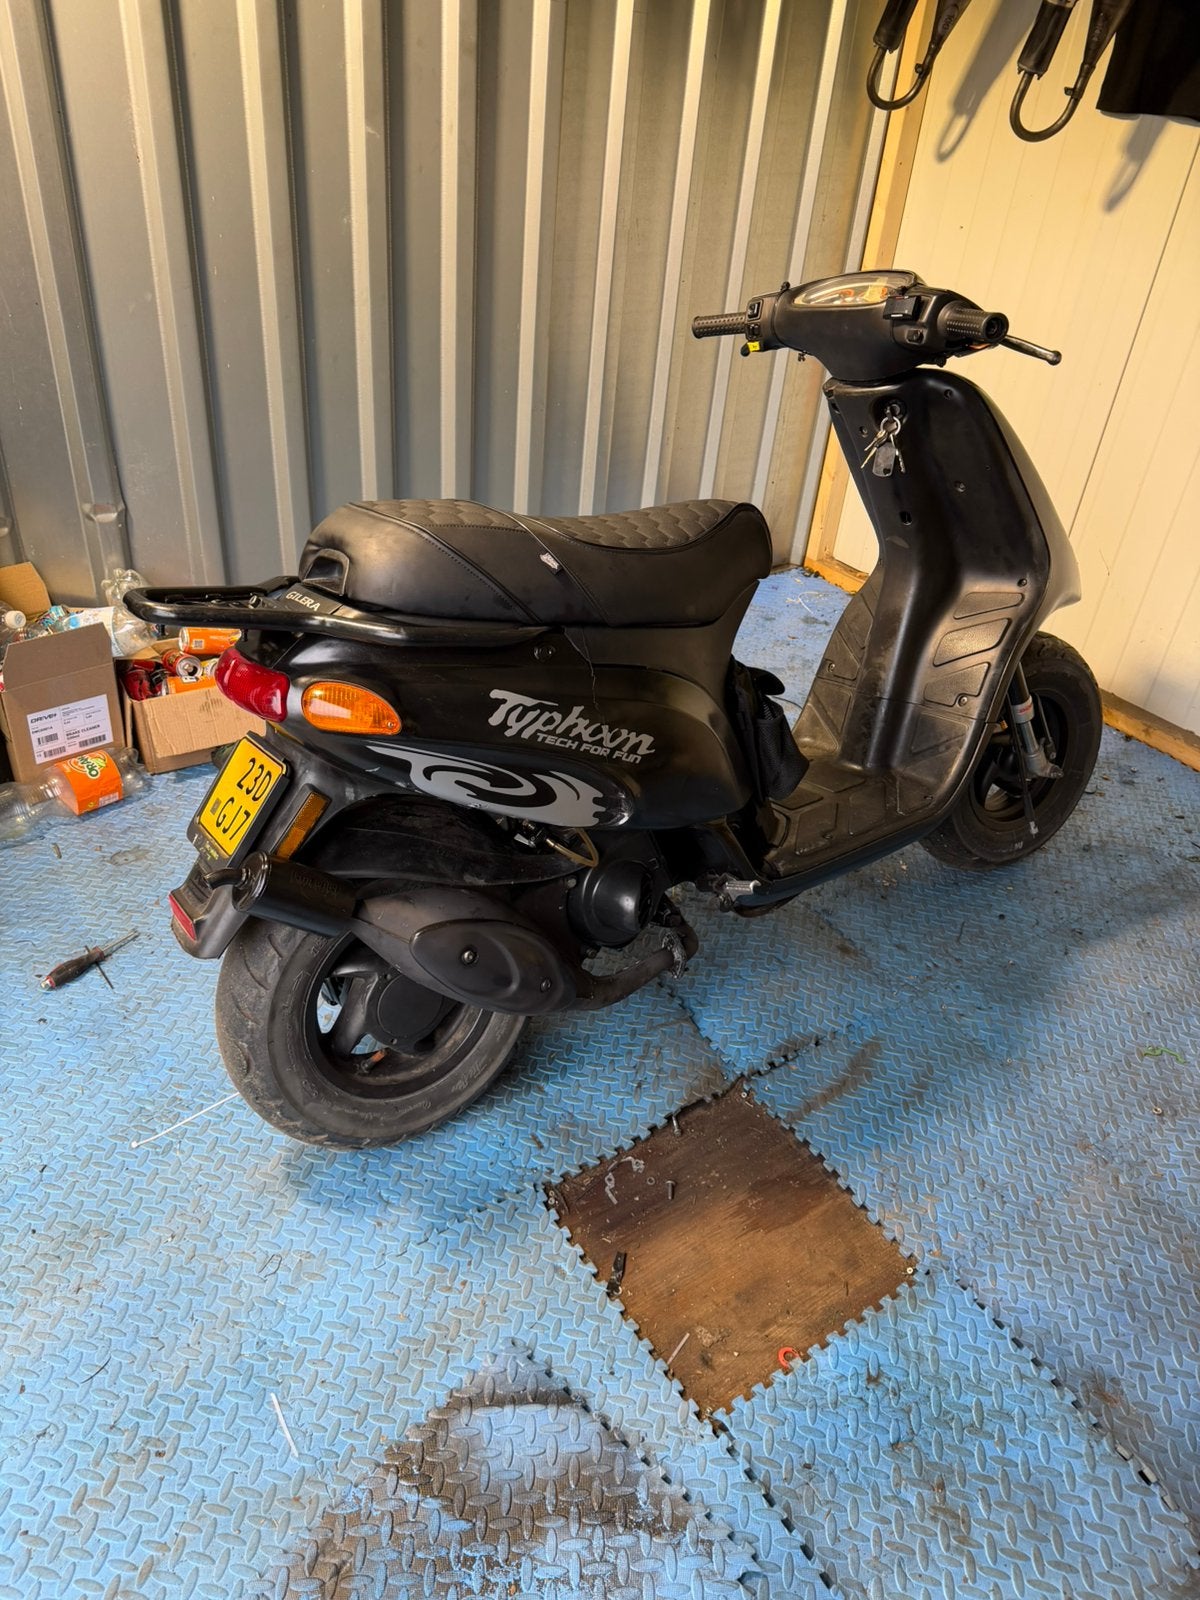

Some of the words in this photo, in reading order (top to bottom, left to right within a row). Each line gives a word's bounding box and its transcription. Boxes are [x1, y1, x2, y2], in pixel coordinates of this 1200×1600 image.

[285, 591, 321, 612] GILERA
[487, 688, 656, 755] Typhoon
[537, 732, 579, 750] TECH
[580, 743, 610, 757] FOR
[236, 757, 272, 802] 23D
[215, 796, 251, 840] GJ7
